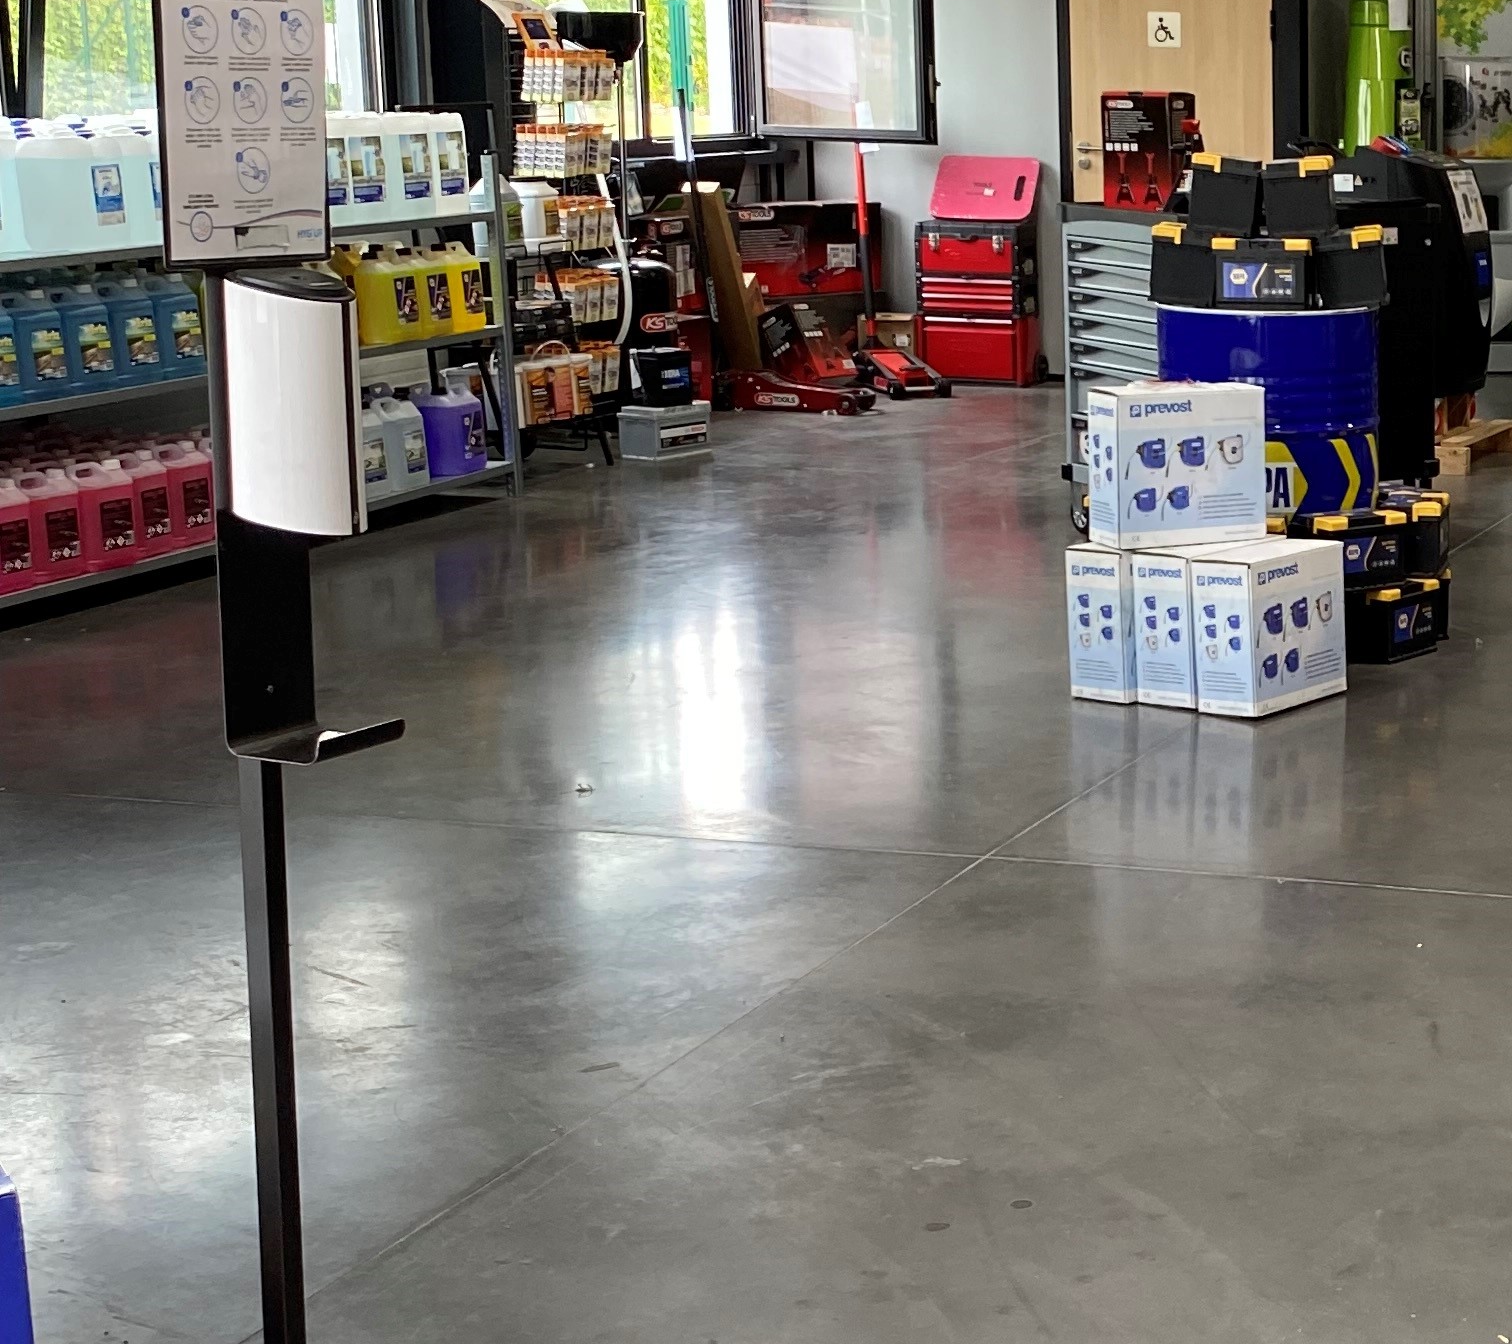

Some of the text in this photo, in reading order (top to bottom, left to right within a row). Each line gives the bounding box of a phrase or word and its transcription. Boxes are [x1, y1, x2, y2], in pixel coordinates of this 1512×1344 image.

[646, 317, 666, 330] KS
[774, 396, 796, 404] TOOLS
[1144, 399, 1193, 418] prevost
[1082, 566, 1116, 578] prevost
[1150, 567, 1183, 579] prevost
[1268, 561, 1299, 583] prevost
[1207, 575, 1243, 587] prevost
